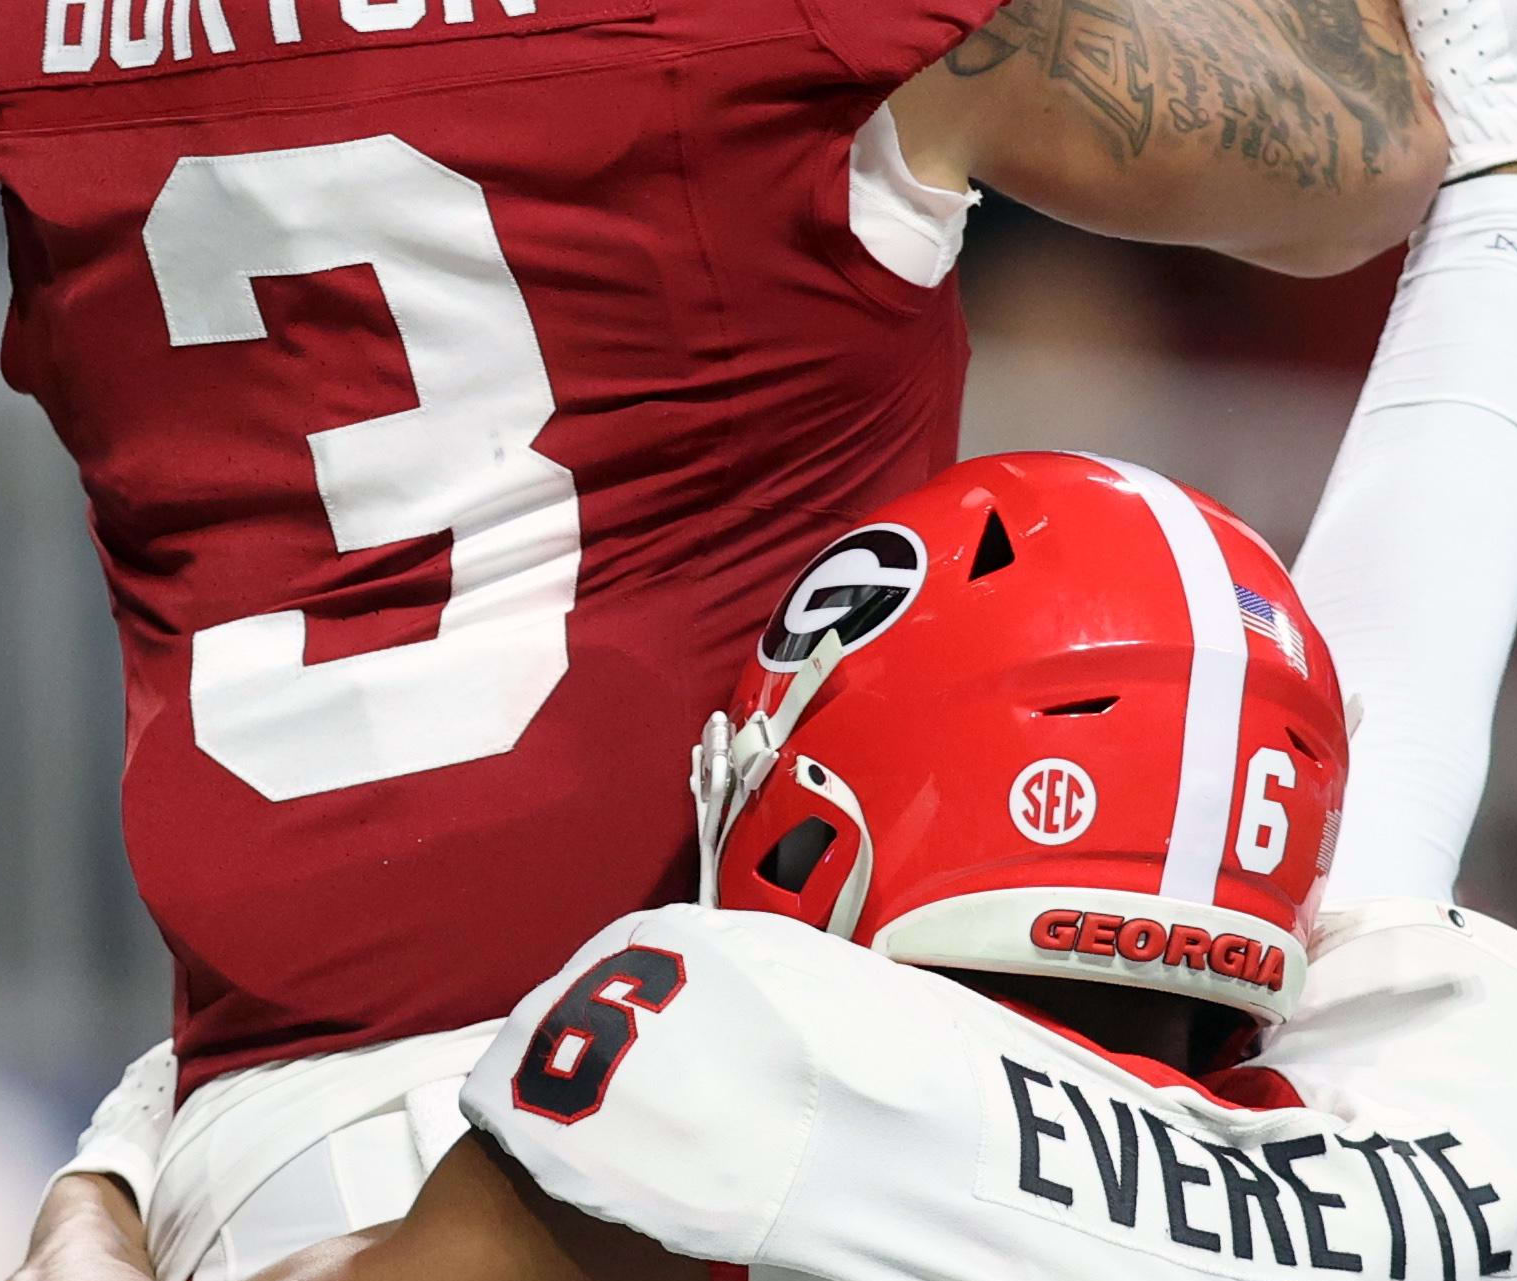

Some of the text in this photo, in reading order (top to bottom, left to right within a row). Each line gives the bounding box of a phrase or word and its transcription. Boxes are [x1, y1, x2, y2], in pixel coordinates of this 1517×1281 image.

[142, 134, 581, 804] 3
[761, 529, 918, 662] G
[1022, 769, 1085, 834] SEC
[1234, 746, 1297, 876] 6
[1030, 908, 1285, 992] GEORGIA
[510, 943, 686, 1125] 6
[1000, 1054, 1512, 1281] EVERETTE
